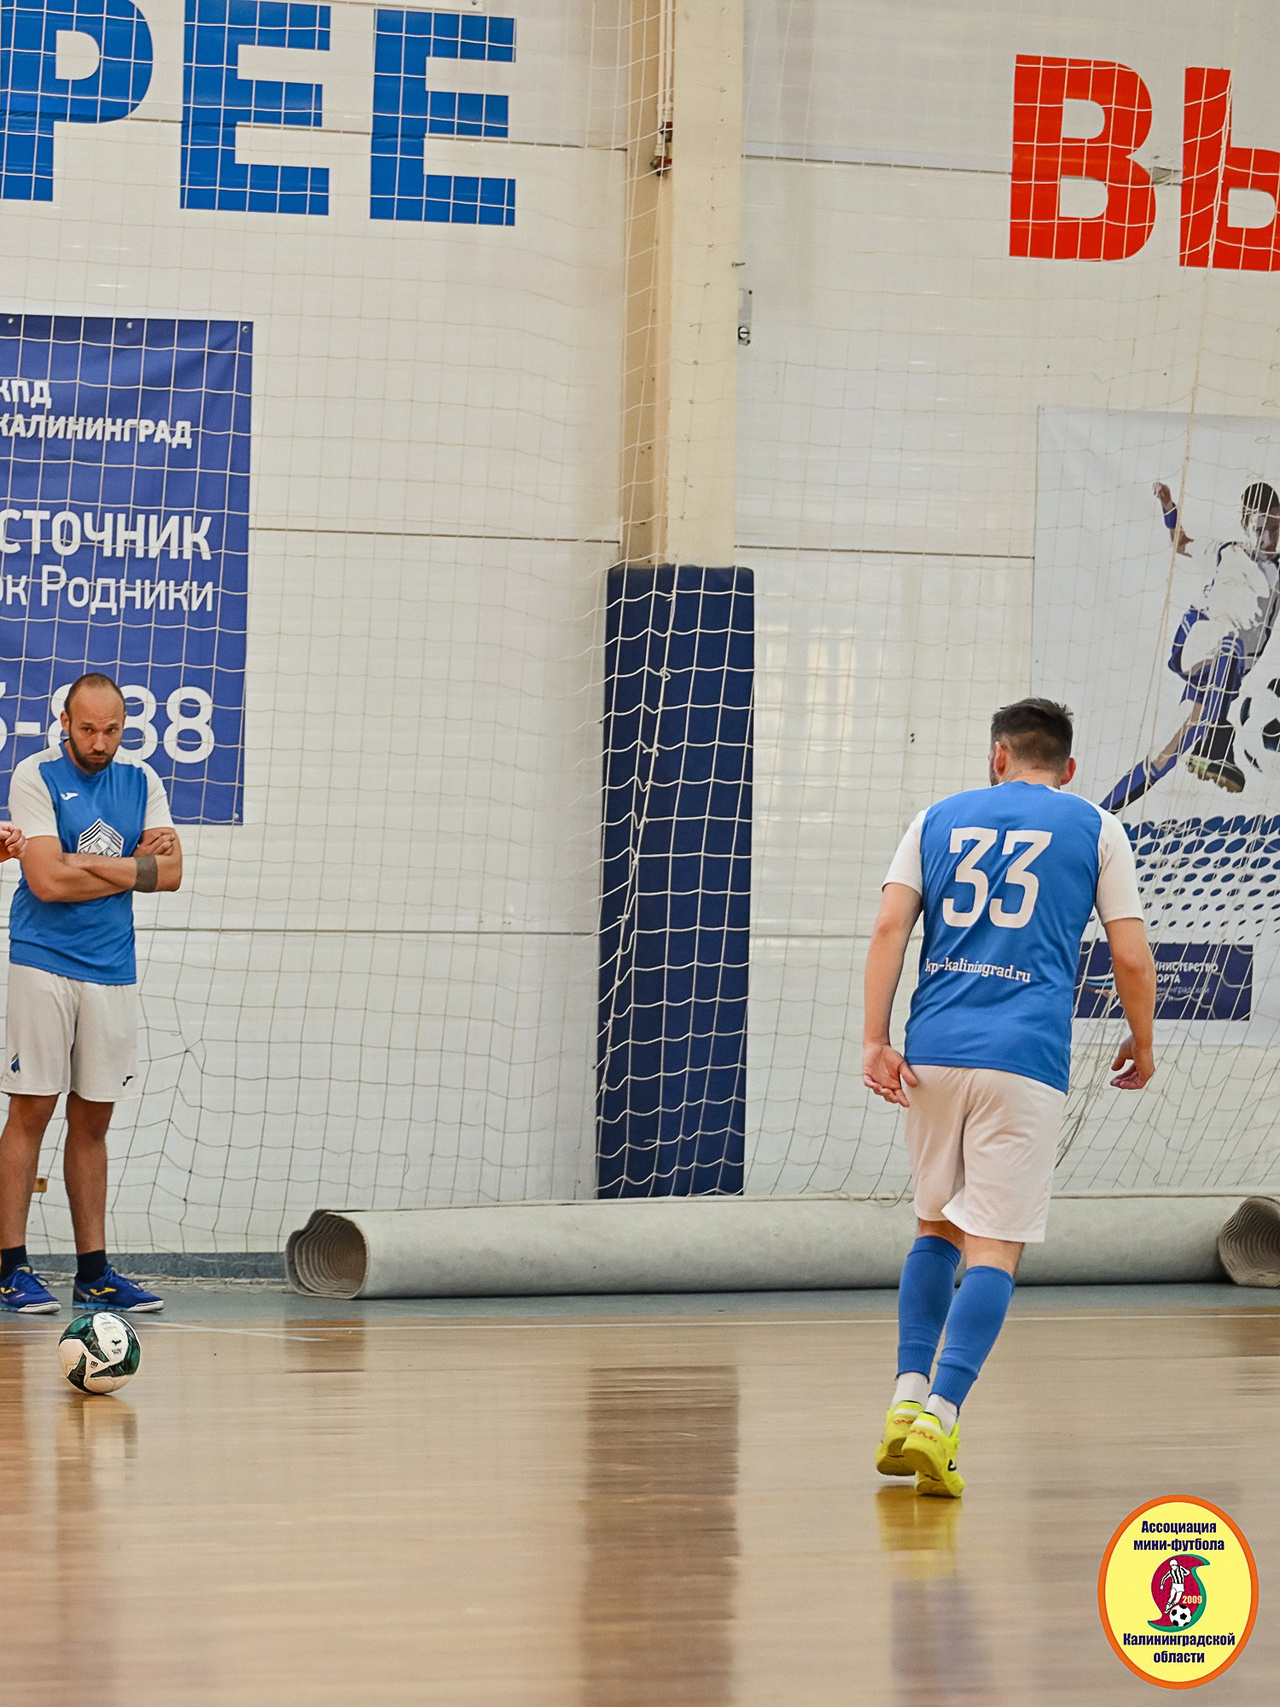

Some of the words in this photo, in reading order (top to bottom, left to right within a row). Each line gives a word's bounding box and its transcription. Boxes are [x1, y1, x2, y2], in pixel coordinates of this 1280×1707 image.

[40, 564, 214, 616] Родники
[942, 826, 1053, 929] 33
[1155, 961, 1219, 973] ИНИСТЕРСТВО
[1156, 973, 1181, 984] ОРТА
